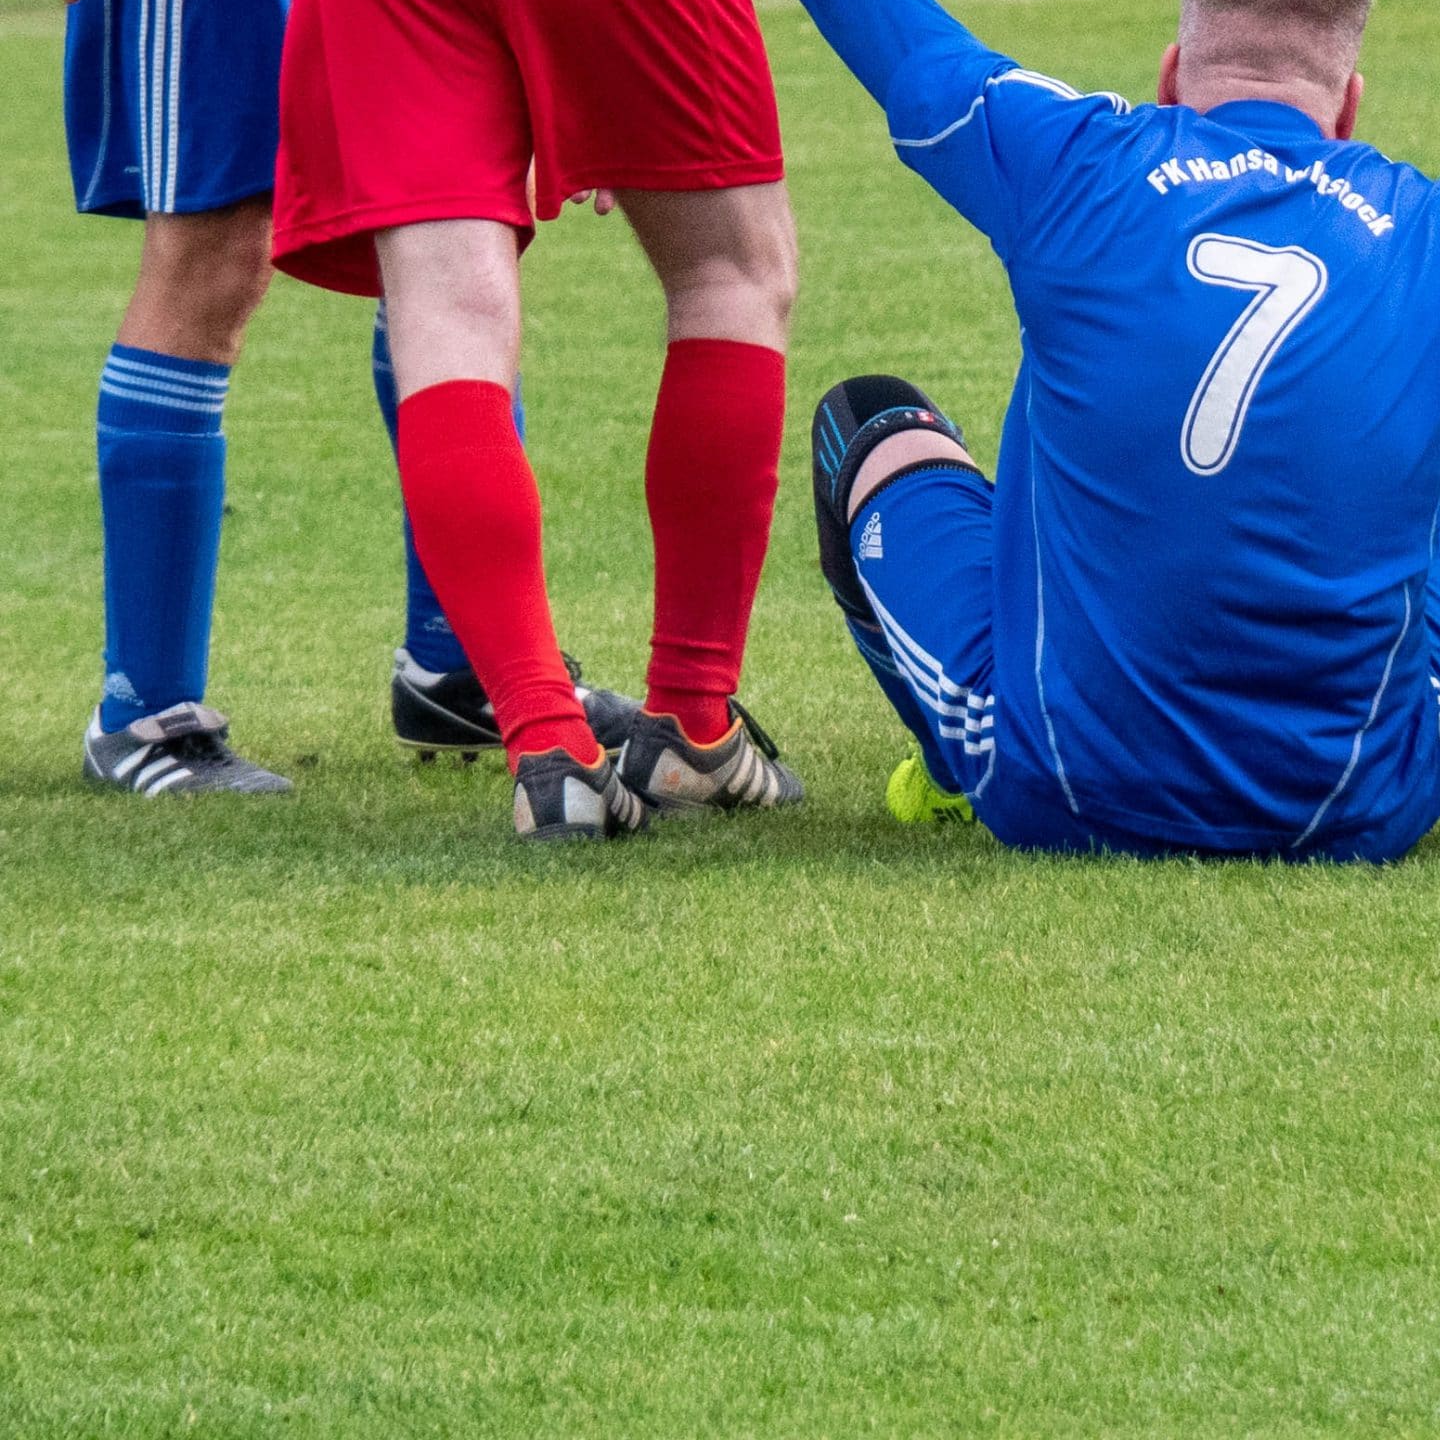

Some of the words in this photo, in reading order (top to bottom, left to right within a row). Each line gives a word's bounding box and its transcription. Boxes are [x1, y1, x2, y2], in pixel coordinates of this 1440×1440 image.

[1147, 157, 1190, 195] FK
[1186, 148, 1279, 182] Hansa
[1179, 231, 1329, 477] 7
